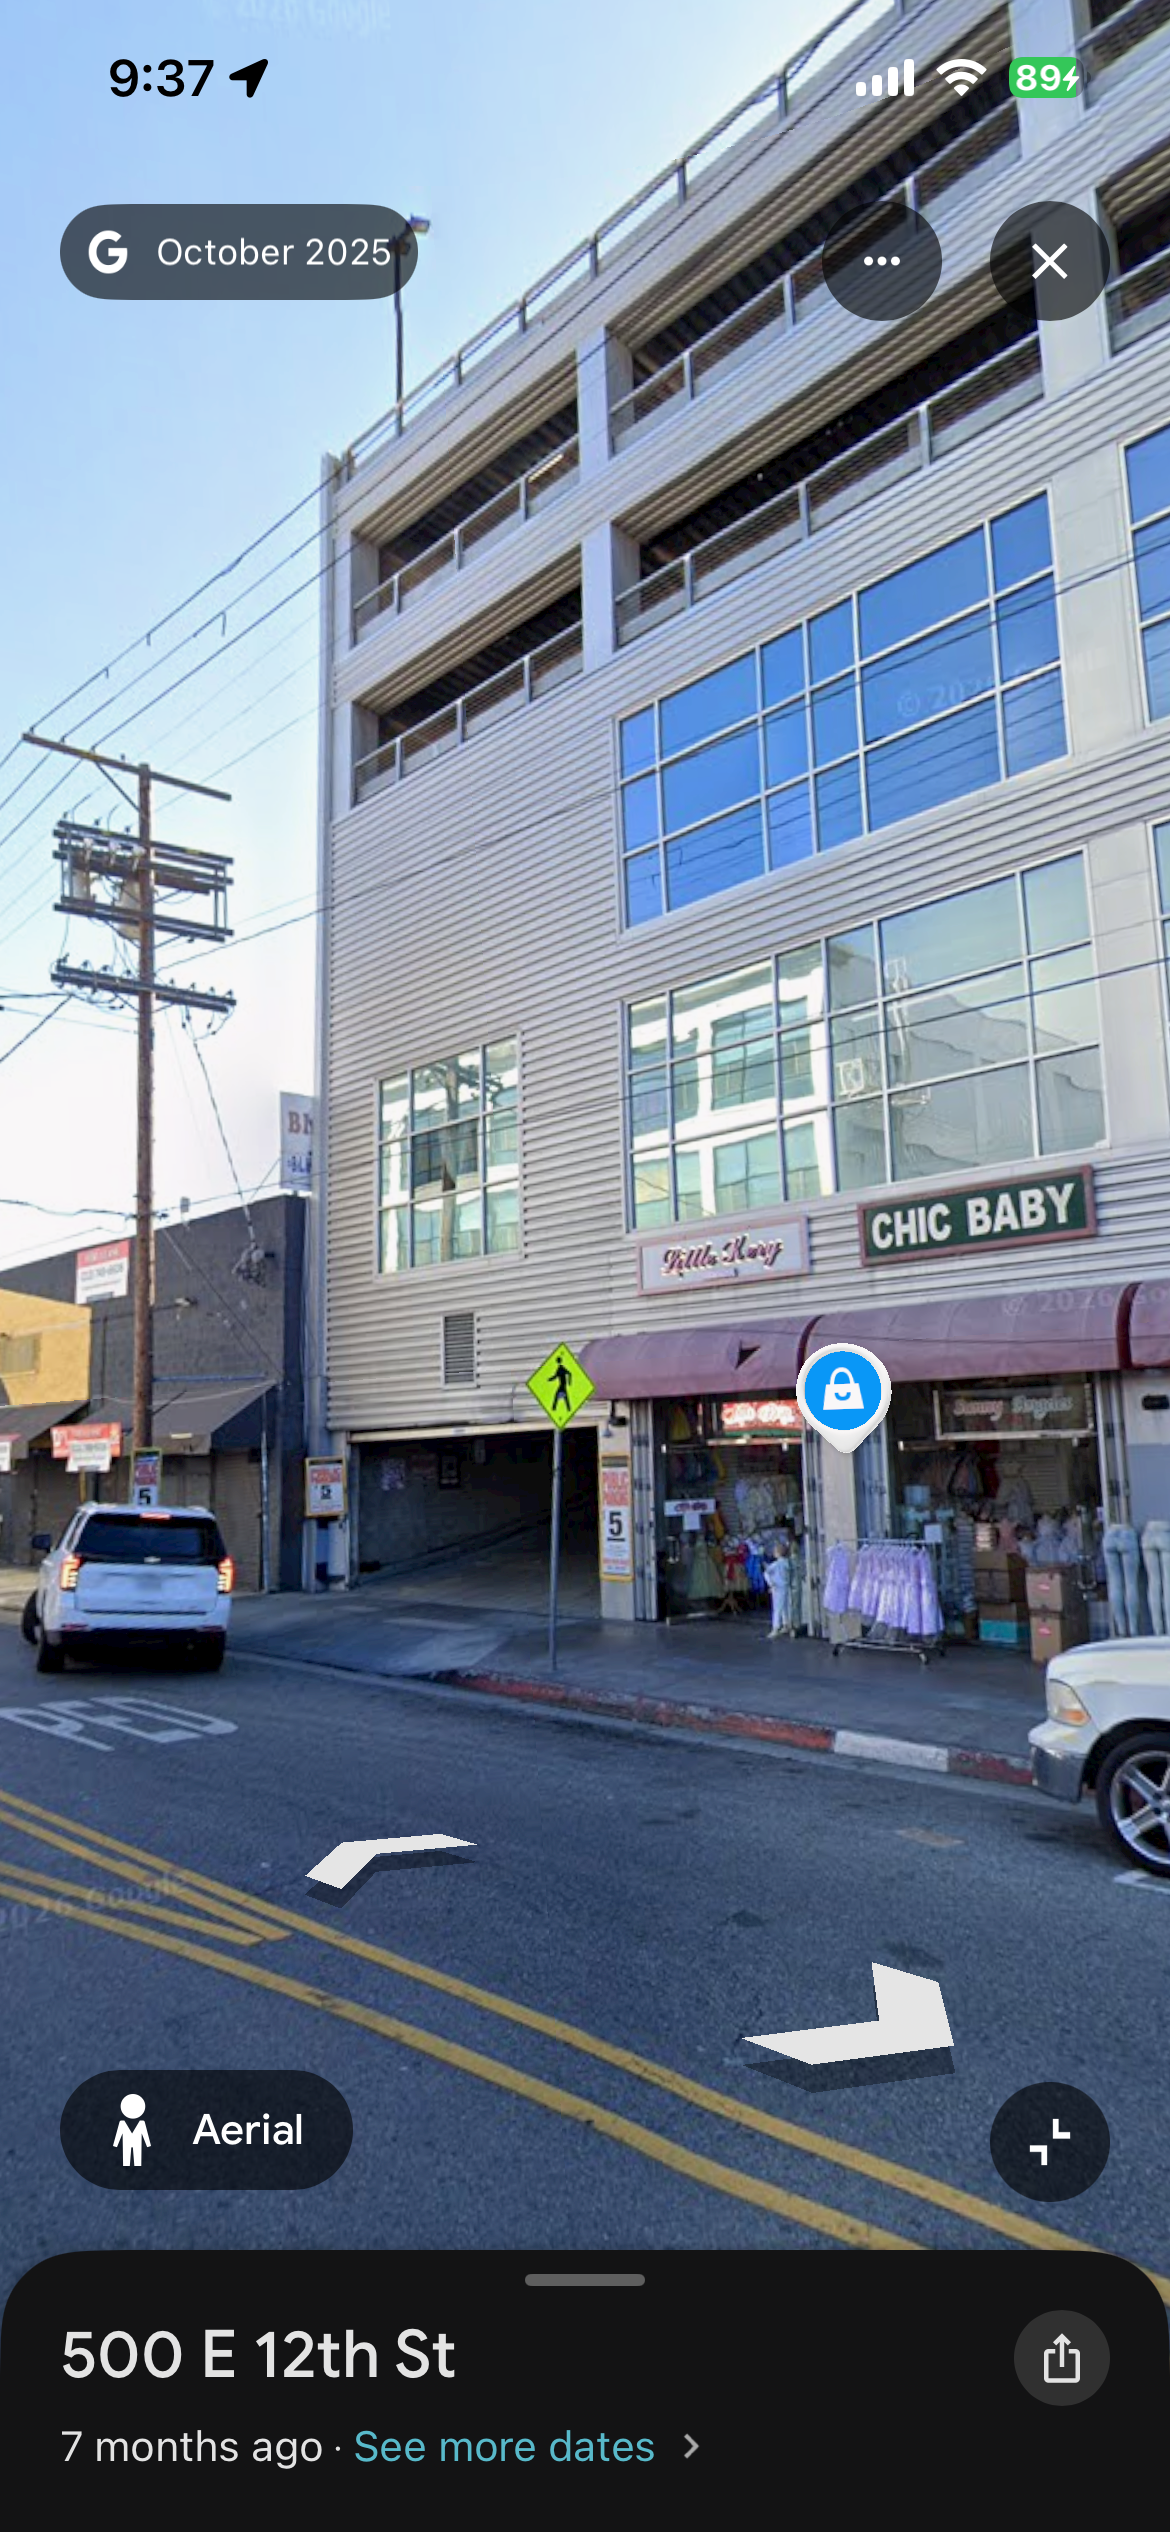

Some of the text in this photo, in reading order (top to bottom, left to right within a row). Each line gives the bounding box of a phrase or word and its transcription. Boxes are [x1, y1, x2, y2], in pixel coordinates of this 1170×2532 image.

[871, 1182, 1075, 1250] CHIC BABY
[608, 1511, 623, 1537] 5
[0, 1696, 238, 1752] PED
